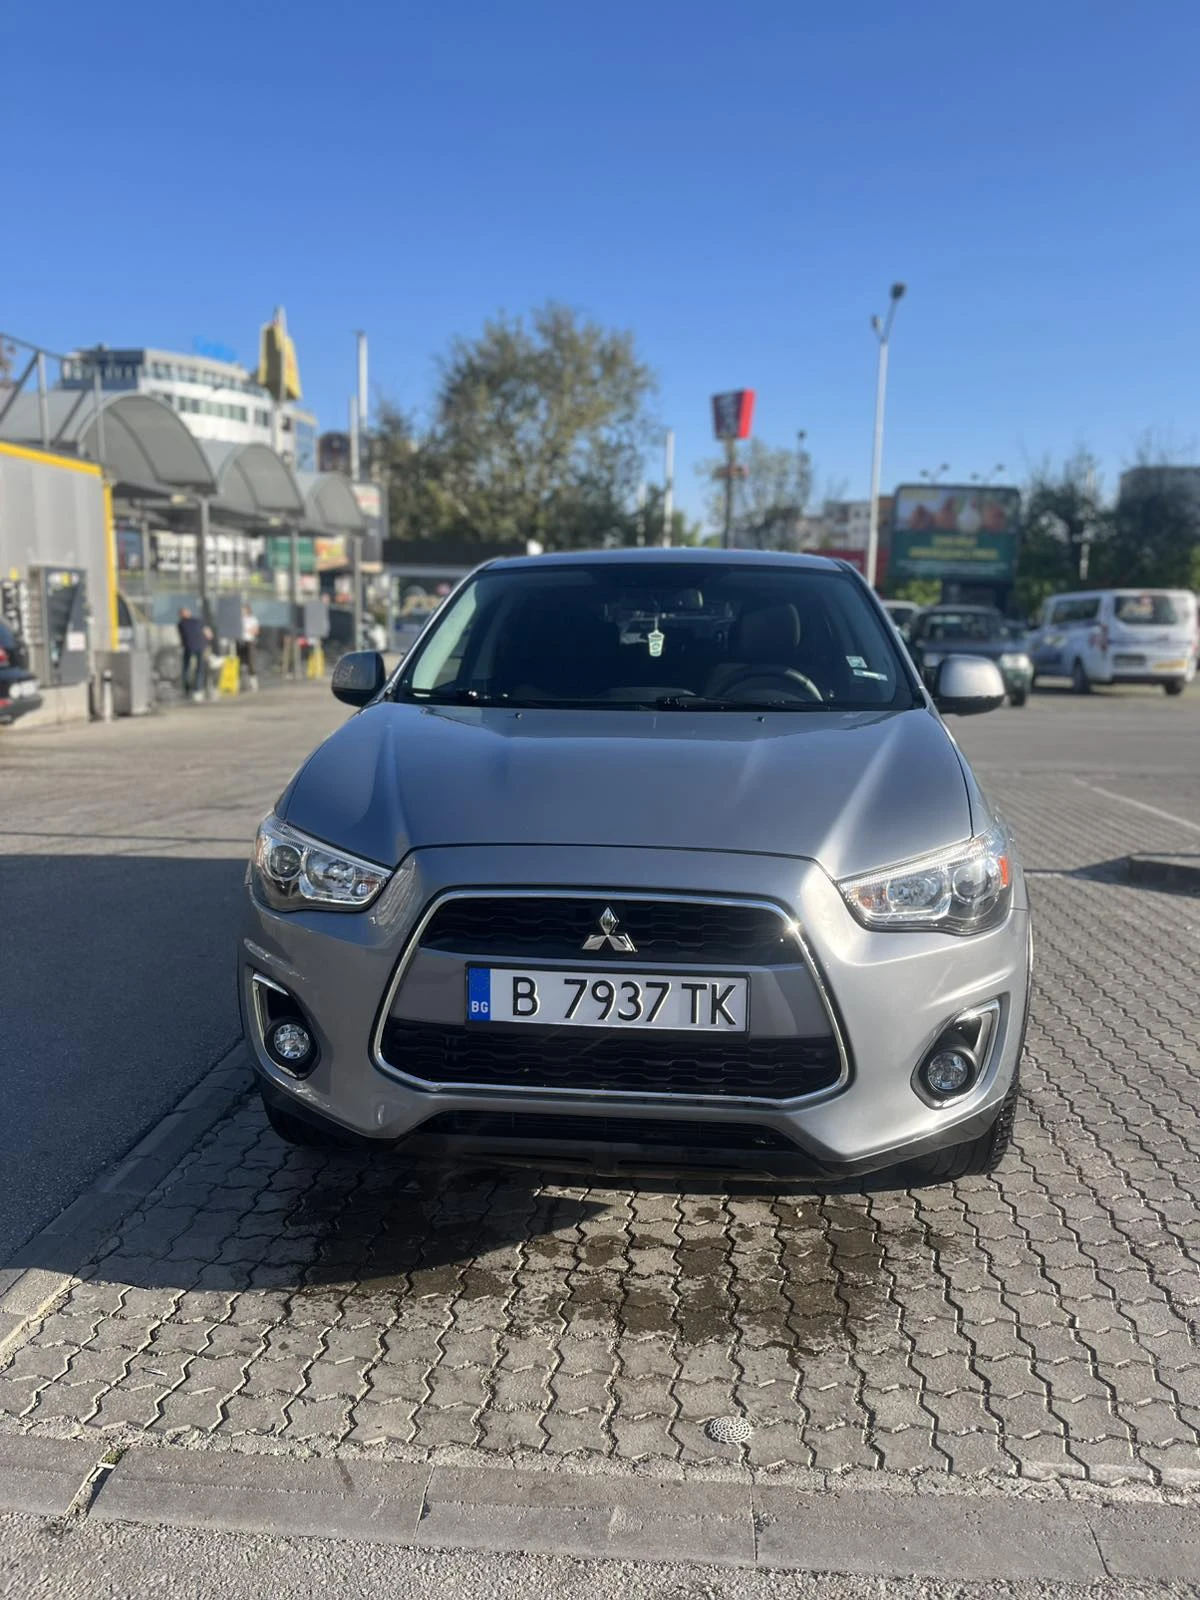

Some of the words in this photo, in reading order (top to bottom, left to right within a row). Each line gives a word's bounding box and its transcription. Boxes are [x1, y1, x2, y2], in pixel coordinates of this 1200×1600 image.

[471, 1000, 489, 1013] BG
[512, 976, 539, 1017] B
[564, 979, 672, 1022] 7937
[681, 983, 737, 1025] TK
